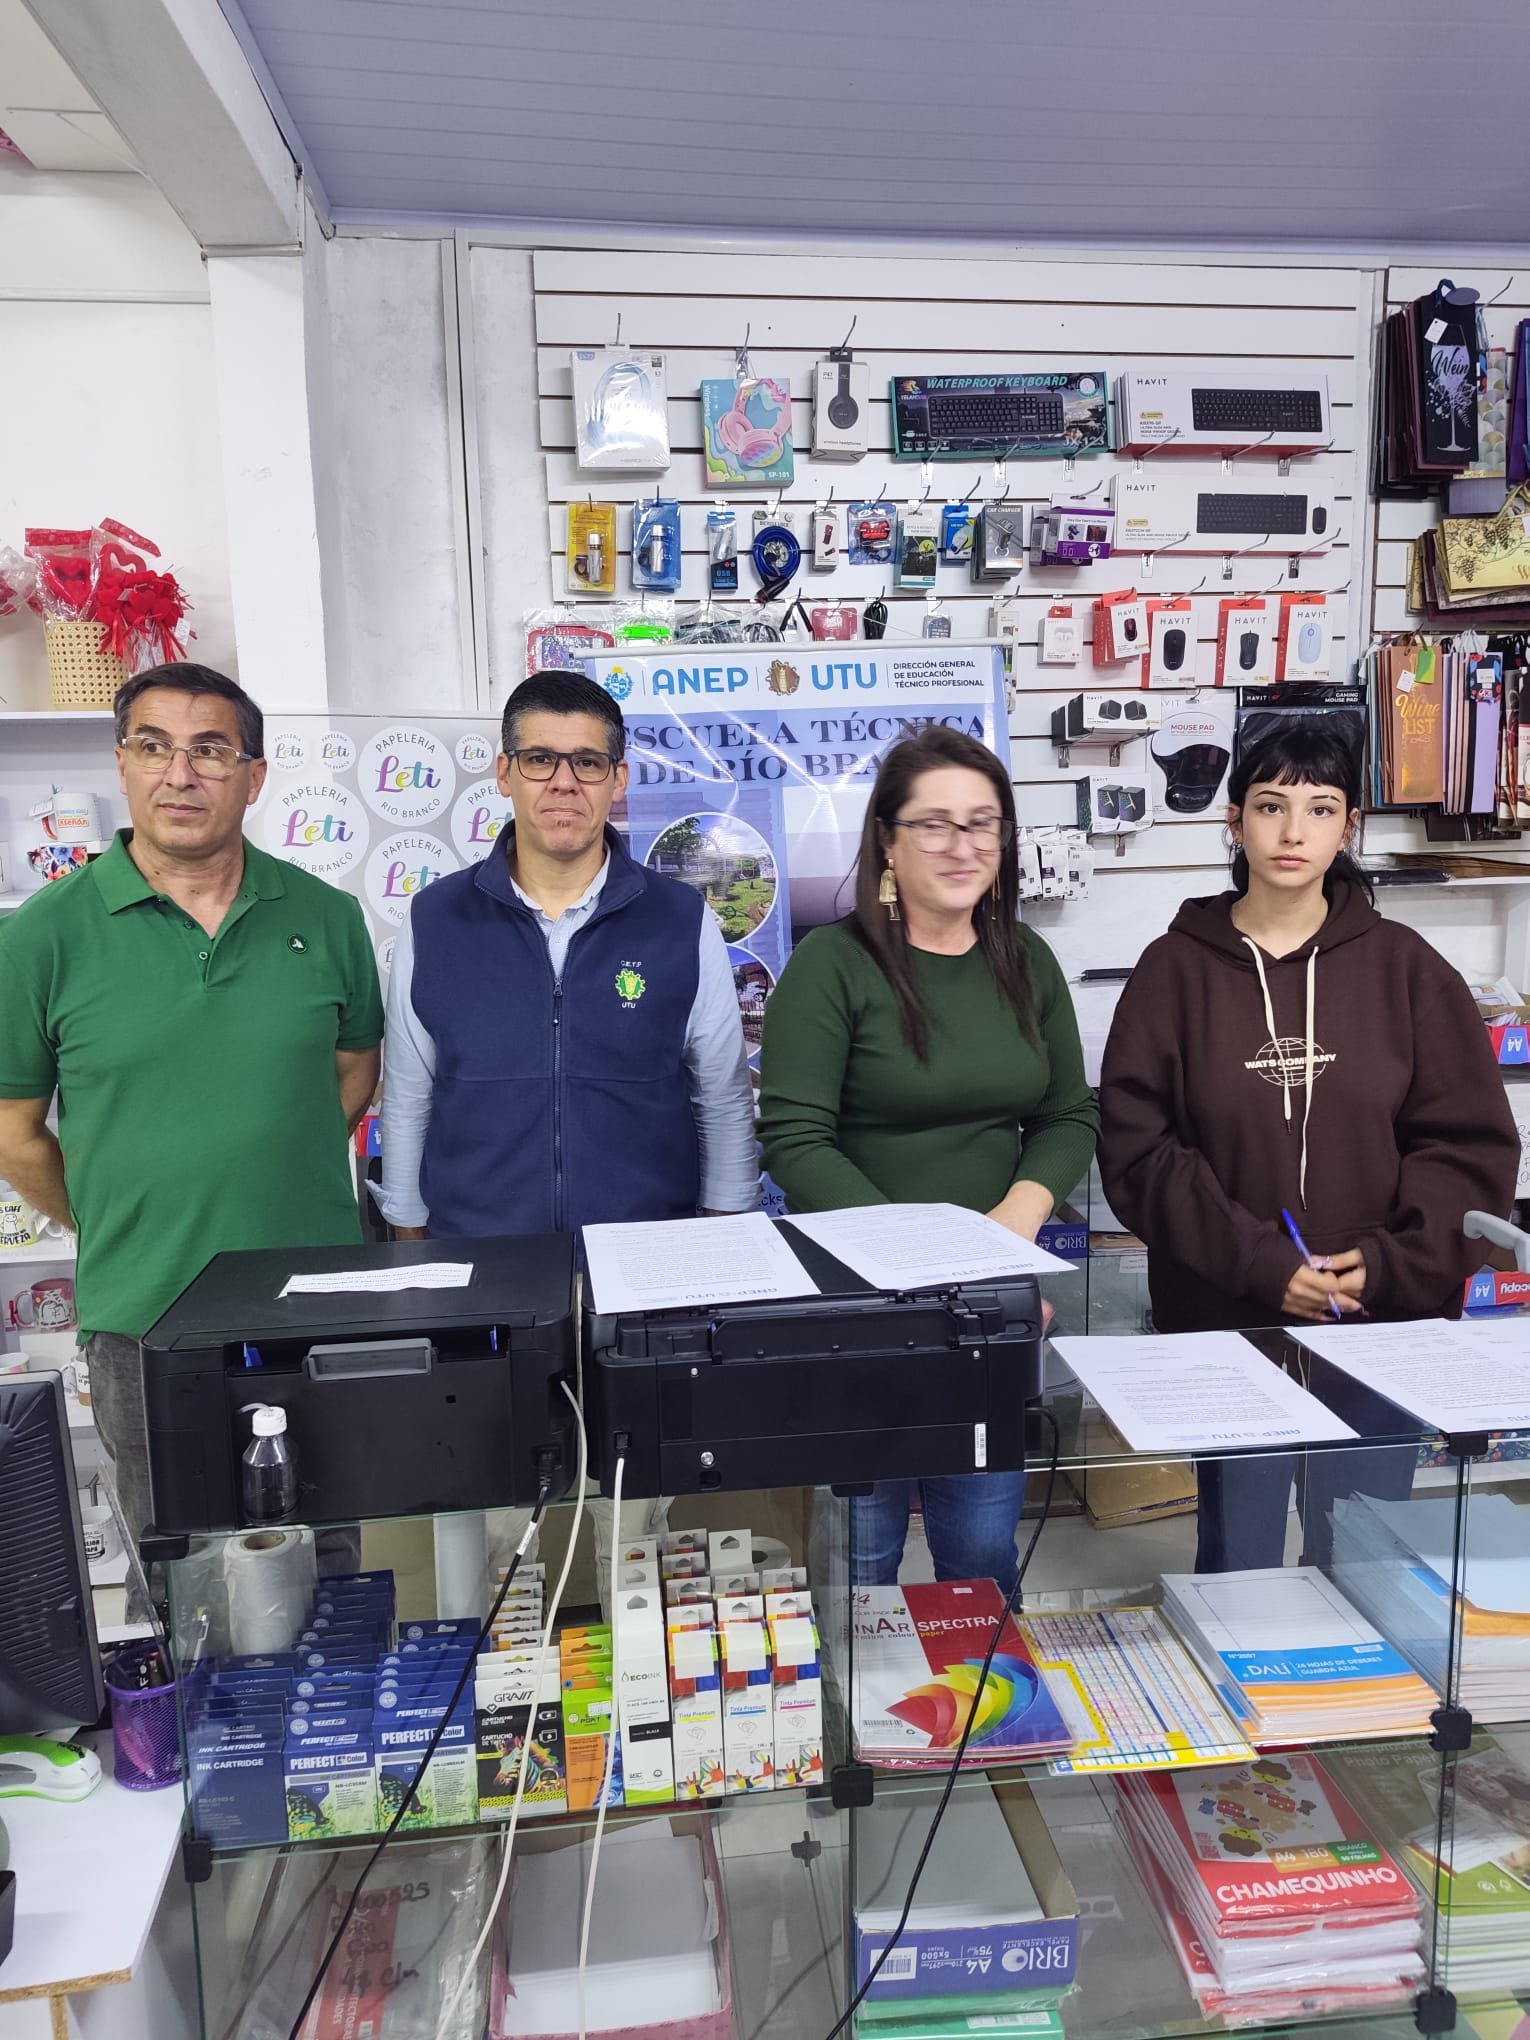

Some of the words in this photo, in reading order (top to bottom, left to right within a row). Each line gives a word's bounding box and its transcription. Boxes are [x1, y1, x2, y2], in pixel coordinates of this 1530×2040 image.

[1431, 347, 1469, 377] Wein
[926, 378, 1004, 389] WATERPROOF
[1005, 376, 1068, 387] KEYBOARD
[768, 471, 790, 479] SP-101
[1117, 607, 1141, 617] HAVIT
[1297, 611, 1329, 619] HAVIT
[1160, 617, 1191, 625] HAVIT
[1235, 617, 1267, 625] HAVIT
[1217, 628, 1225, 669] HAVIT
[893, 660, 937, 669] DIRECCIÓN
[938, 660, 976, 668] GENERAL
[811, 663, 877, 691] UTU
[894, 671, 905, 679] DE
[907, 669, 954, 679] EDUCACIÓN
[652, 667, 748, 696] ANEP
[895, 678, 930, 688] TÉCNICO
[931, 679, 985, 688] PROFESIONAL
[1171, 723, 1197, 731] MOUSE
[1404, 718, 1435, 735] LIST
[274, 733, 302, 743] PAPELERIA
[321, 732, 348, 743] PAPELERIA
[375, 732, 436, 754] PAPELERIA
[274, 742, 304, 759] Leti
[321, 742, 350, 759] Leti
[462, 745, 487, 760] Leti
[375, 755, 442, 793] Leti
[636, 760, 696, 785] DE
[712, 750, 788, 782] RÍO
[282, 786, 348, 807] PAPELERIA
[380, 801, 398, 817] RIO
[402, 798, 441, 818] BRANCO
[282, 809, 354, 847] Leti
[382, 839, 443, 859] PAPELERIA
[289, 856, 307, 871] RIO
[311, 852, 353, 873] BRANCO
[387, 906, 405, 920] RIO
[621, 1001, 636, 1009] UTU
[1507, 1037, 1523, 1052] A4
[1244, 1058, 1277, 1069] WATS
[1277, 1053, 1337, 1067] COMANY
[1055, 1236, 1087, 1250] BRIO
[951, 1269, 978, 1277] UTU
[685, 1292, 715, 1300] UTU
[1475, 1284, 1490, 1298] A4
[1260, 1429, 1301, 1438] ANEP
[84, 1539, 100, 1548] EJOR
[917, 1615, 1000, 1632] SPECTRA
[919, 1630, 945, 1638] paper
[1246, 1663, 1291, 1676] DALÍ
[1348, 1657, 1383, 1665] DEBERES
[1300, 1667, 1337, 1675] GUARDA
[631, 1671, 662, 1681] ECOINK
[396, 1708, 428, 1718] PERFECT
[301, 1736, 334, 1746] PERFECT
[381, 1729, 432, 1745] PERFECT
[443, 1726, 464, 1738] Color
[481, 1733, 513, 1741] CARTUCHO
[215, 1742, 266, 1752] CARTRIDGE
[197, 1762, 212, 1771] INK
[213, 1758, 265, 1770] CARTRIDGE
[290, 1755, 335, 1770] PERFECT
[346, 1753, 365, 1764] Color
[1337, 1843, 1368, 1851] BRANCO
[1275, 1851, 1296, 1862] A4
[1302, 1847, 1329, 1859] 180
[1350, 1853, 1377, 1861] FOLHAS
[1217, 1866, 1398, 1902] CHAMEQUINHO
[921, 1951, 949, 1960] 5x500
[1002, 1944, 1069, 1973] BRIO
[966, 1959, 991, 1975] A4
